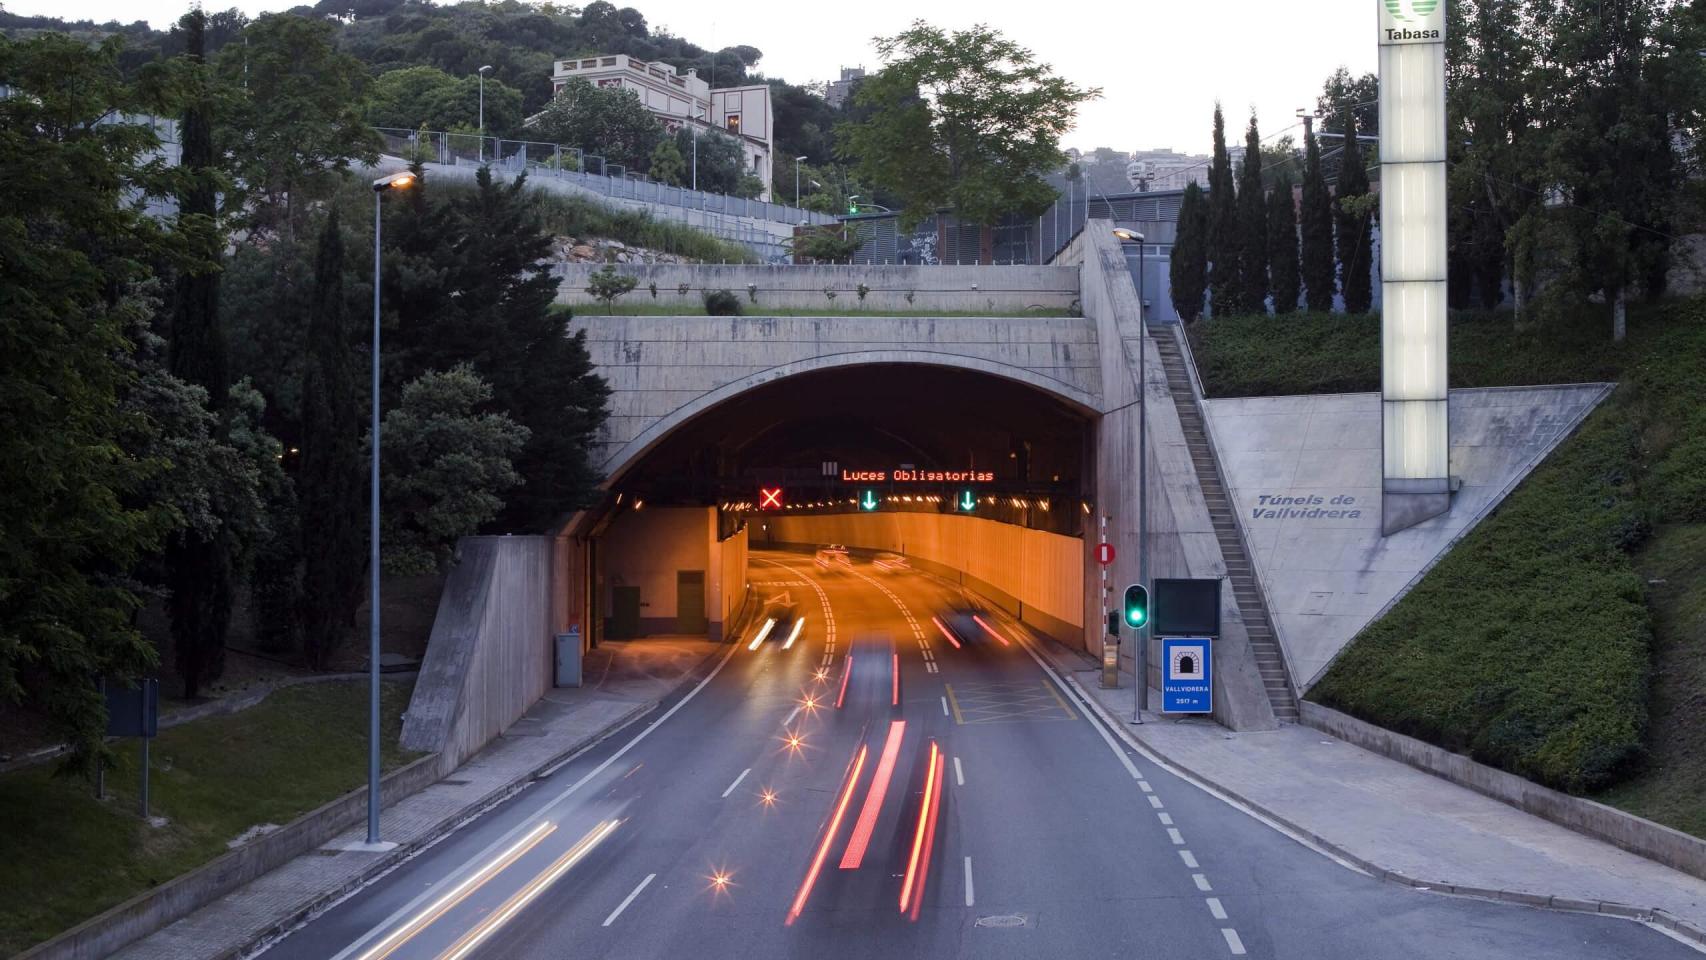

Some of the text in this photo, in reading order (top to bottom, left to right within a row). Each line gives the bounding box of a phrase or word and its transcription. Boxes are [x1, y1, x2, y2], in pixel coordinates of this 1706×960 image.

[1385, 28, 1439, 40] Tabasa
[843, 469, 885, 481] Luces
[1259, 494, 1356, 505] Túnels de
[1252, 507, 1361, 519] Vallvidrera
